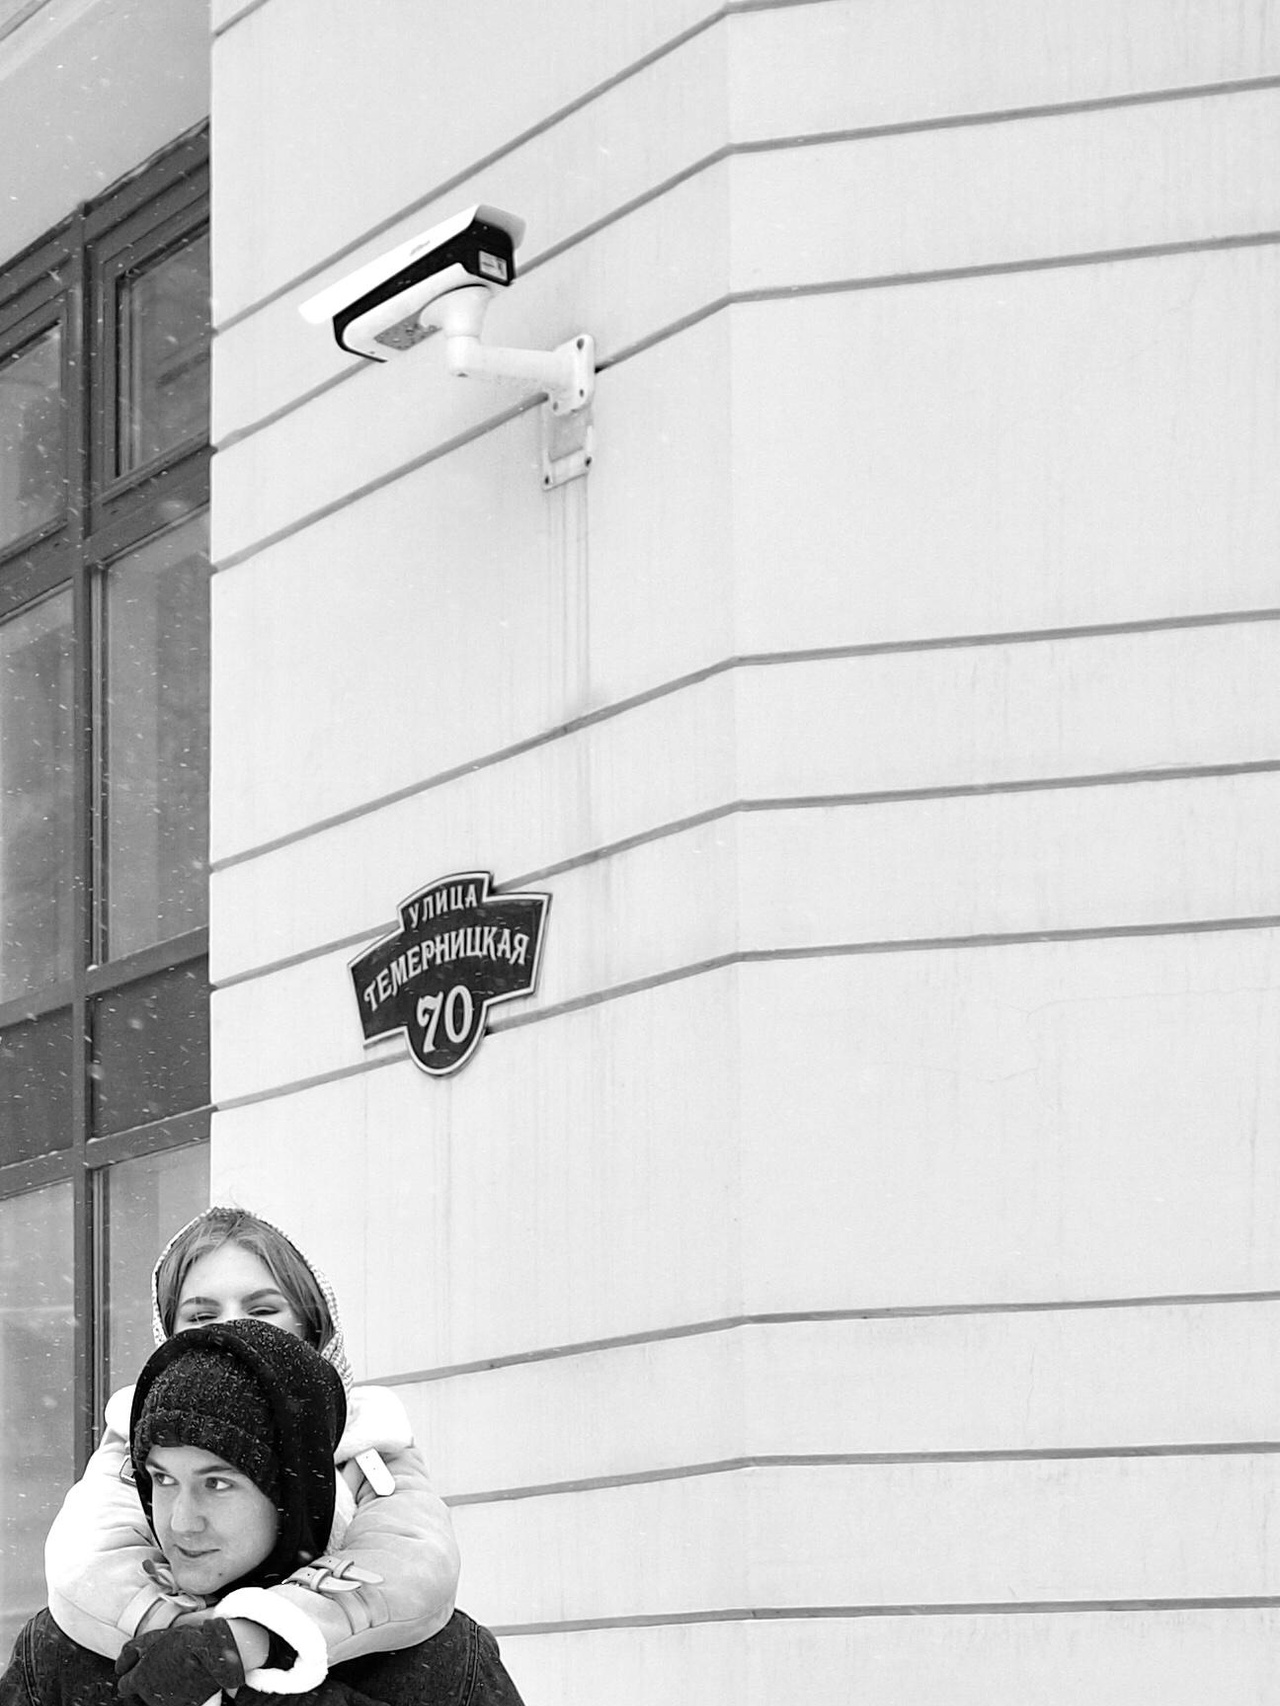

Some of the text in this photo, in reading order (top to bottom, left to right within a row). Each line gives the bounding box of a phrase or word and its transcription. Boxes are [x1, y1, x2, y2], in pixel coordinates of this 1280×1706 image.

[409, 884, 477, 927] УЛИЦА
[364, 927, 529, 1012] ТЕМЕРНИЦКАЯ
[417, 985, 472, 1053] 70
